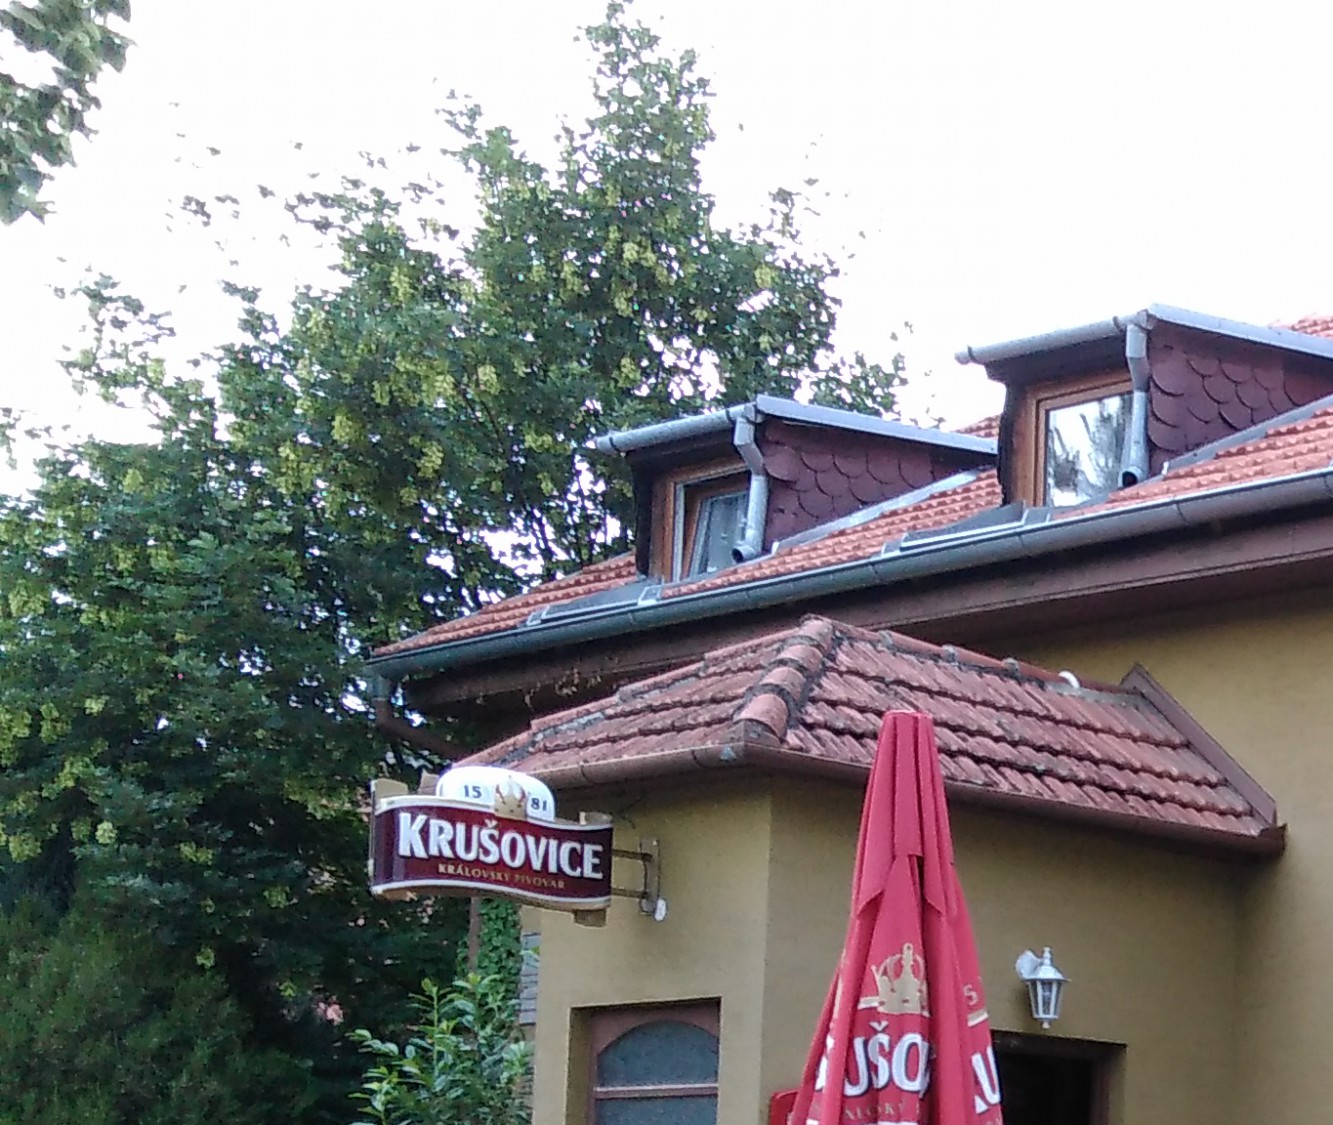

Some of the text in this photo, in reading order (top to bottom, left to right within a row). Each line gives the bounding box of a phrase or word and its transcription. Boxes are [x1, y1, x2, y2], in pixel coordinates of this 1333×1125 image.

[463, 785, 547, 812] 15 81
[397, 811, 603, 880] KRUŠOVICE
[438, 863, 565, 889] KRÁLOVSKÝ PIVOVAR
